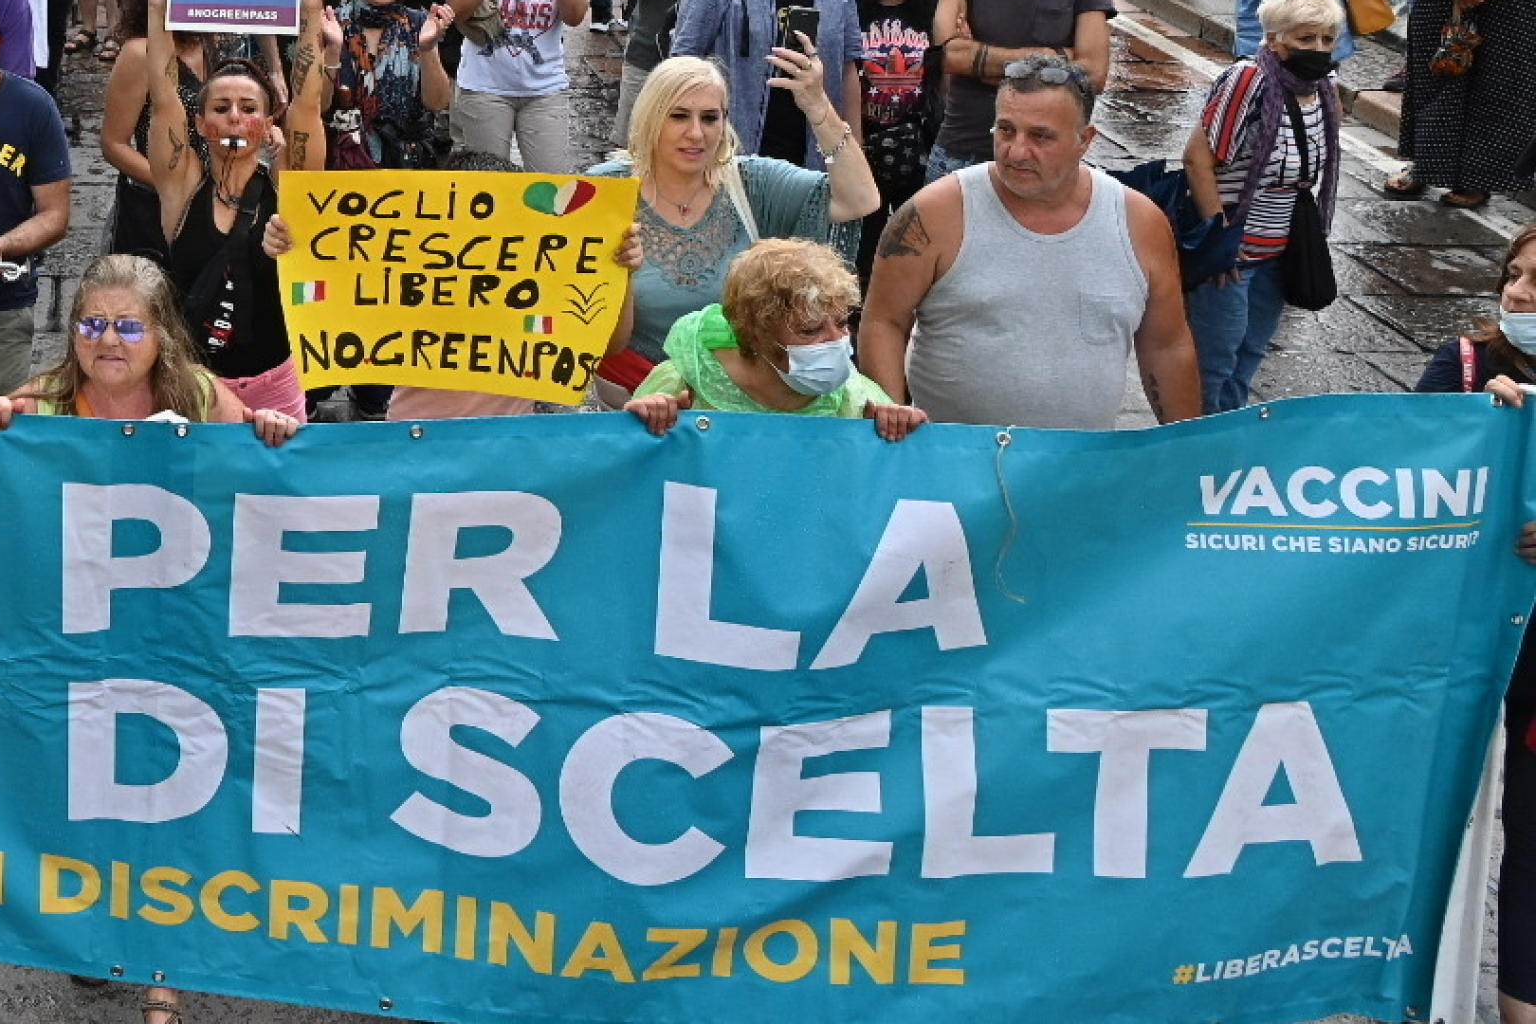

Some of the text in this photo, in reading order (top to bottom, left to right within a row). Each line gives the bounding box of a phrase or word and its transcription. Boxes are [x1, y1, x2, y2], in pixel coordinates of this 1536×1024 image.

[187, 7, 279, 21] #NOGREENPASS
[309, 223, 605, 274] CRESCERE
[1199, 465, 1490, 520] VACCINI
[1184, 530, 1481, 554] SICURI CHE SIANO SICURI?
[61, 481, 563, 641] PER
[654, 480, 988, 671] LA
[67, 677, 307, 834] DI
[389, 685, 1364, 887] SCELTA
[39, 853, 967, 988] DISCRIMINAZIONE
[1171, 932, 1415, 986] #LIBERASCELTA
